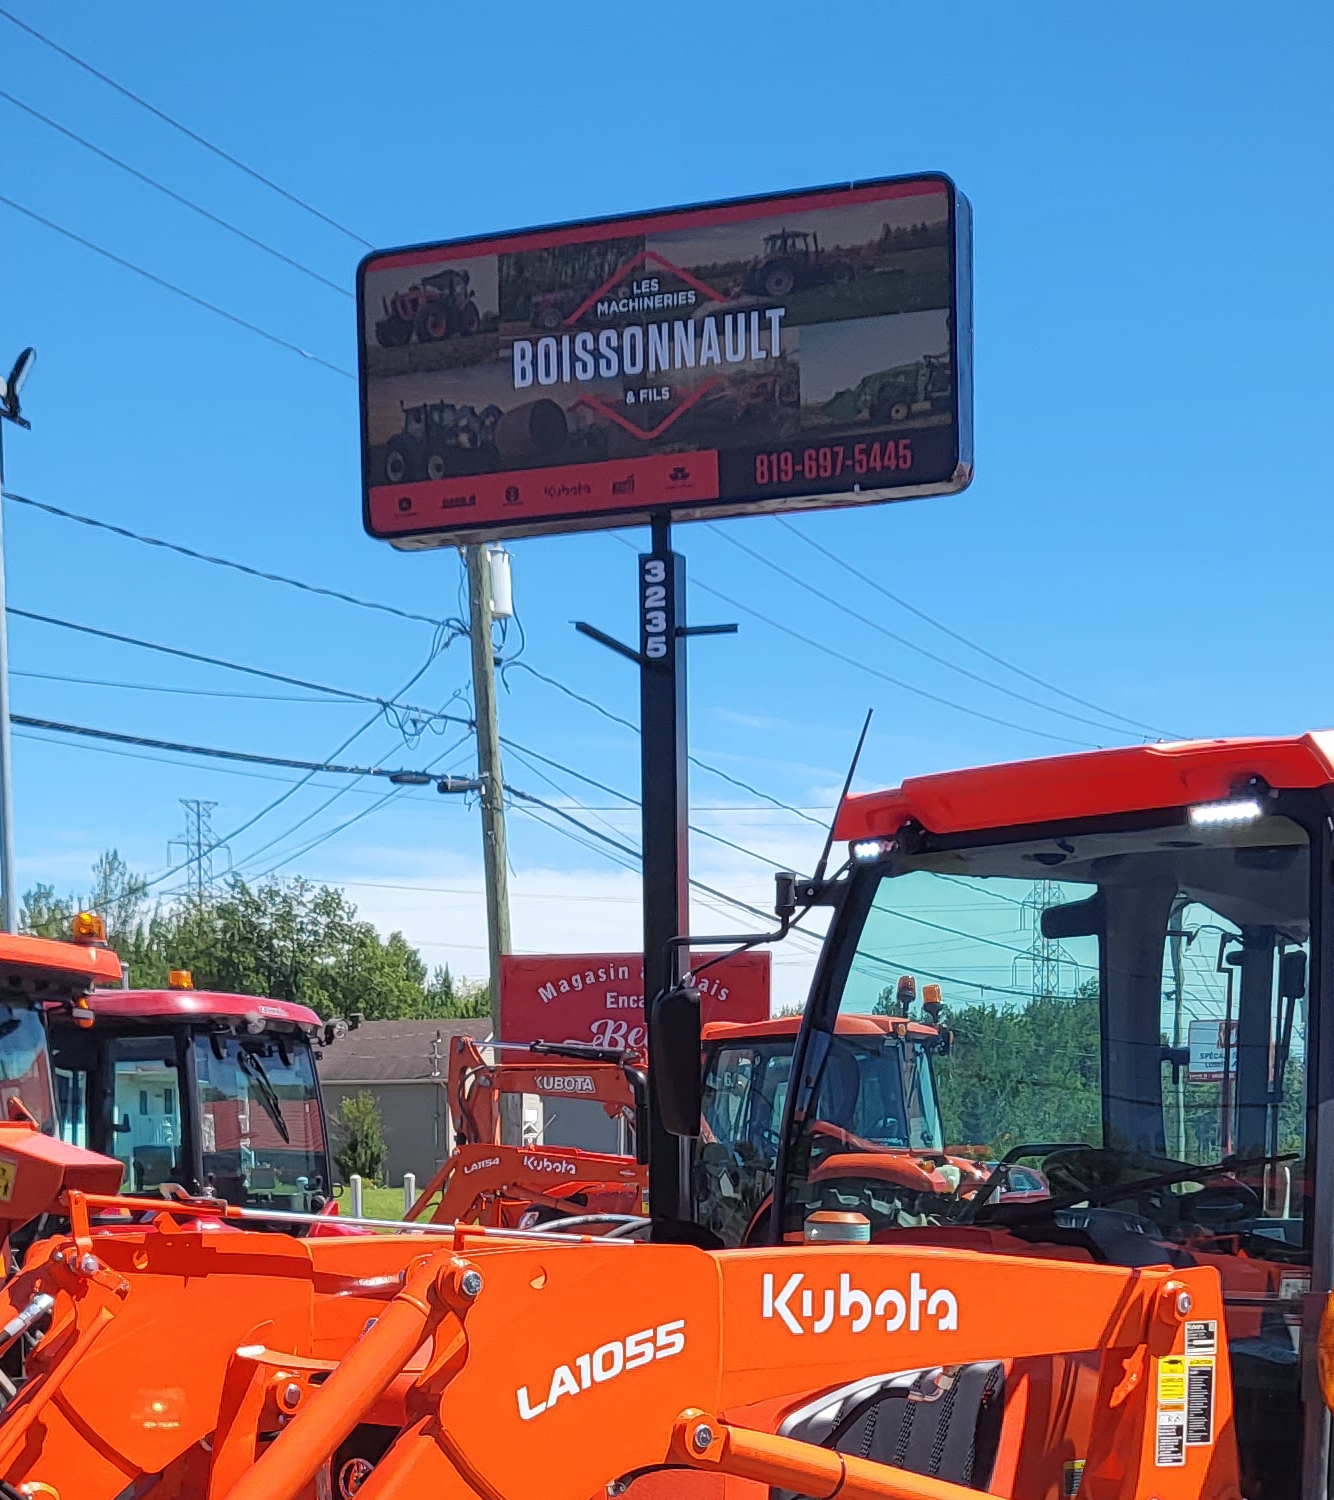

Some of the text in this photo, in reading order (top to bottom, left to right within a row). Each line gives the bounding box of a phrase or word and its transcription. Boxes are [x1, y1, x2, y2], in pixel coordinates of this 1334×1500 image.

[597, 290, 697, 316] MACHINERIES
[632, 278, 660, 295] LES
[513, 307, 786, 390] BOISSONNAULT
[625, 386, 670, 405] & FILS
[755, 438, 912, 485] 819-697-5445
[643, 560, 667, 659] 3235
[537, 963, 629, 1003] Magasin
[534, 1075, 595, 1092] KUBOTA
[523, 1155, 576, 1175] Kubota
[761, 1272, 959, 1335] Kubota
[516, 1319, 686, 1421] LA1055
